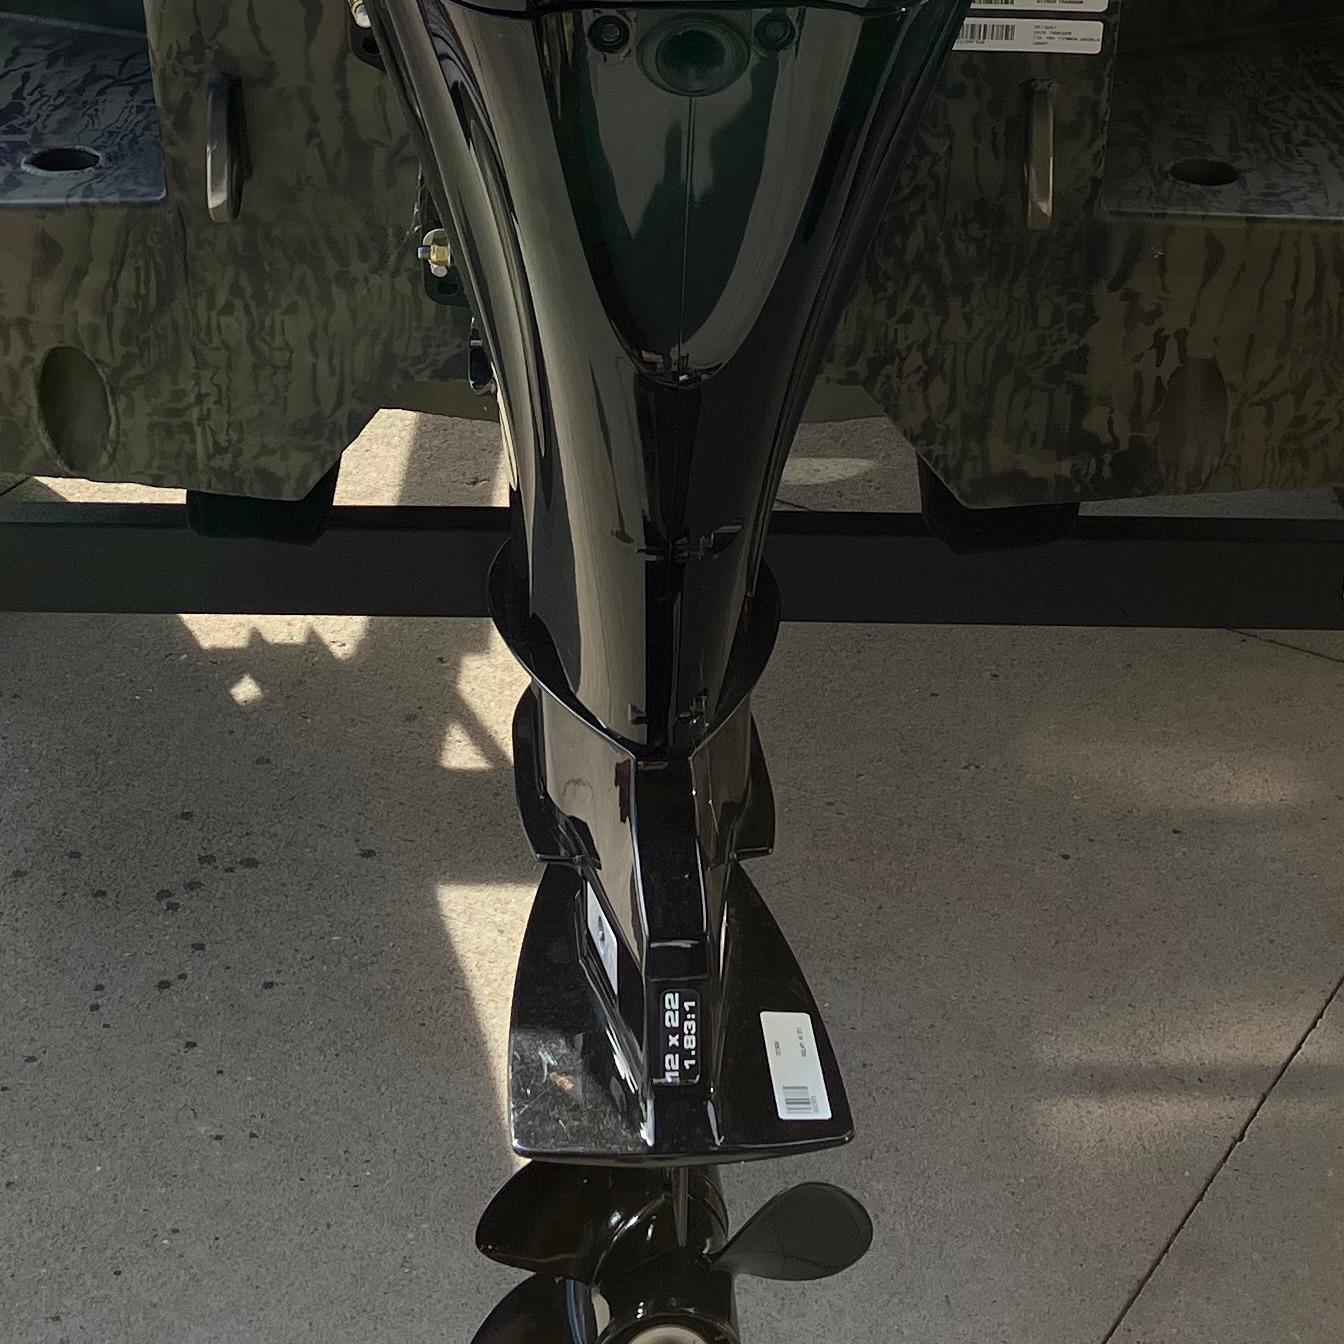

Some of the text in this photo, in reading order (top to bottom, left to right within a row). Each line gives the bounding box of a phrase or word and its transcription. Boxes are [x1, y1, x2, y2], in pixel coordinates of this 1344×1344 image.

[664, 992, 680, 1083] 12 x 22
[683, 1001, 697, 1070] 1.83:1
